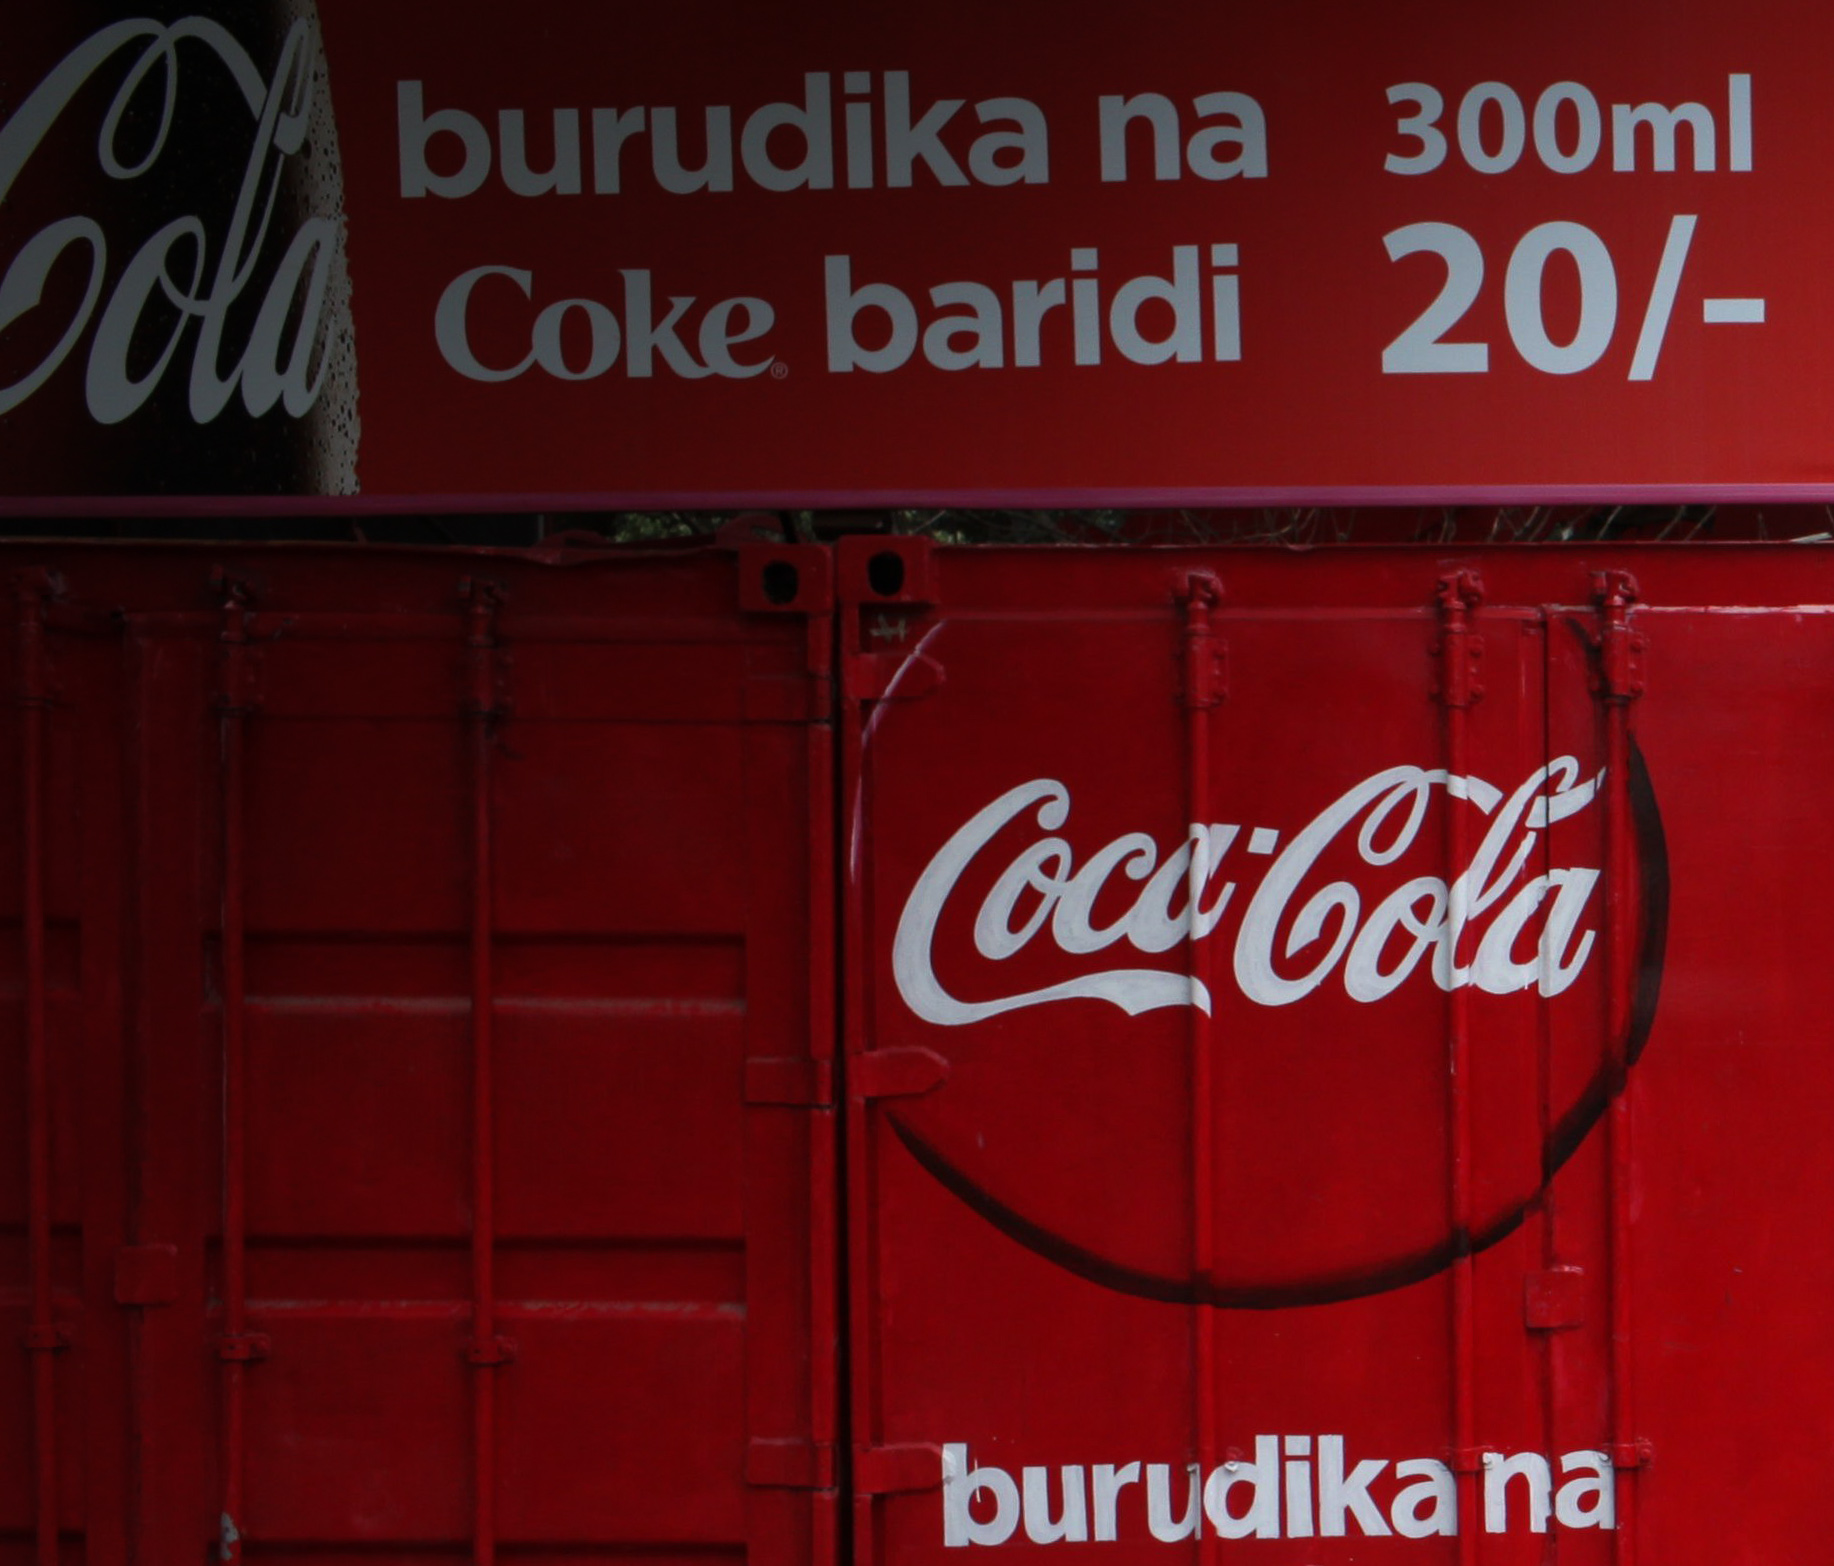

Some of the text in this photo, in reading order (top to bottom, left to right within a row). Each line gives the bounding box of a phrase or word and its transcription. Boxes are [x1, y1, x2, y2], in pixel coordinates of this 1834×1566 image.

[398, 71, 1268, 198] burudika na
[1380, 73, 1753, 175] 300ml
[435, 243, 1242, 382] Coke baridi
[1381, 214, 1766, 381] 20/-
[892, 754, 1606, 1026] Coca-Cola
[942, 1434, 1616, 1548] burudika na
